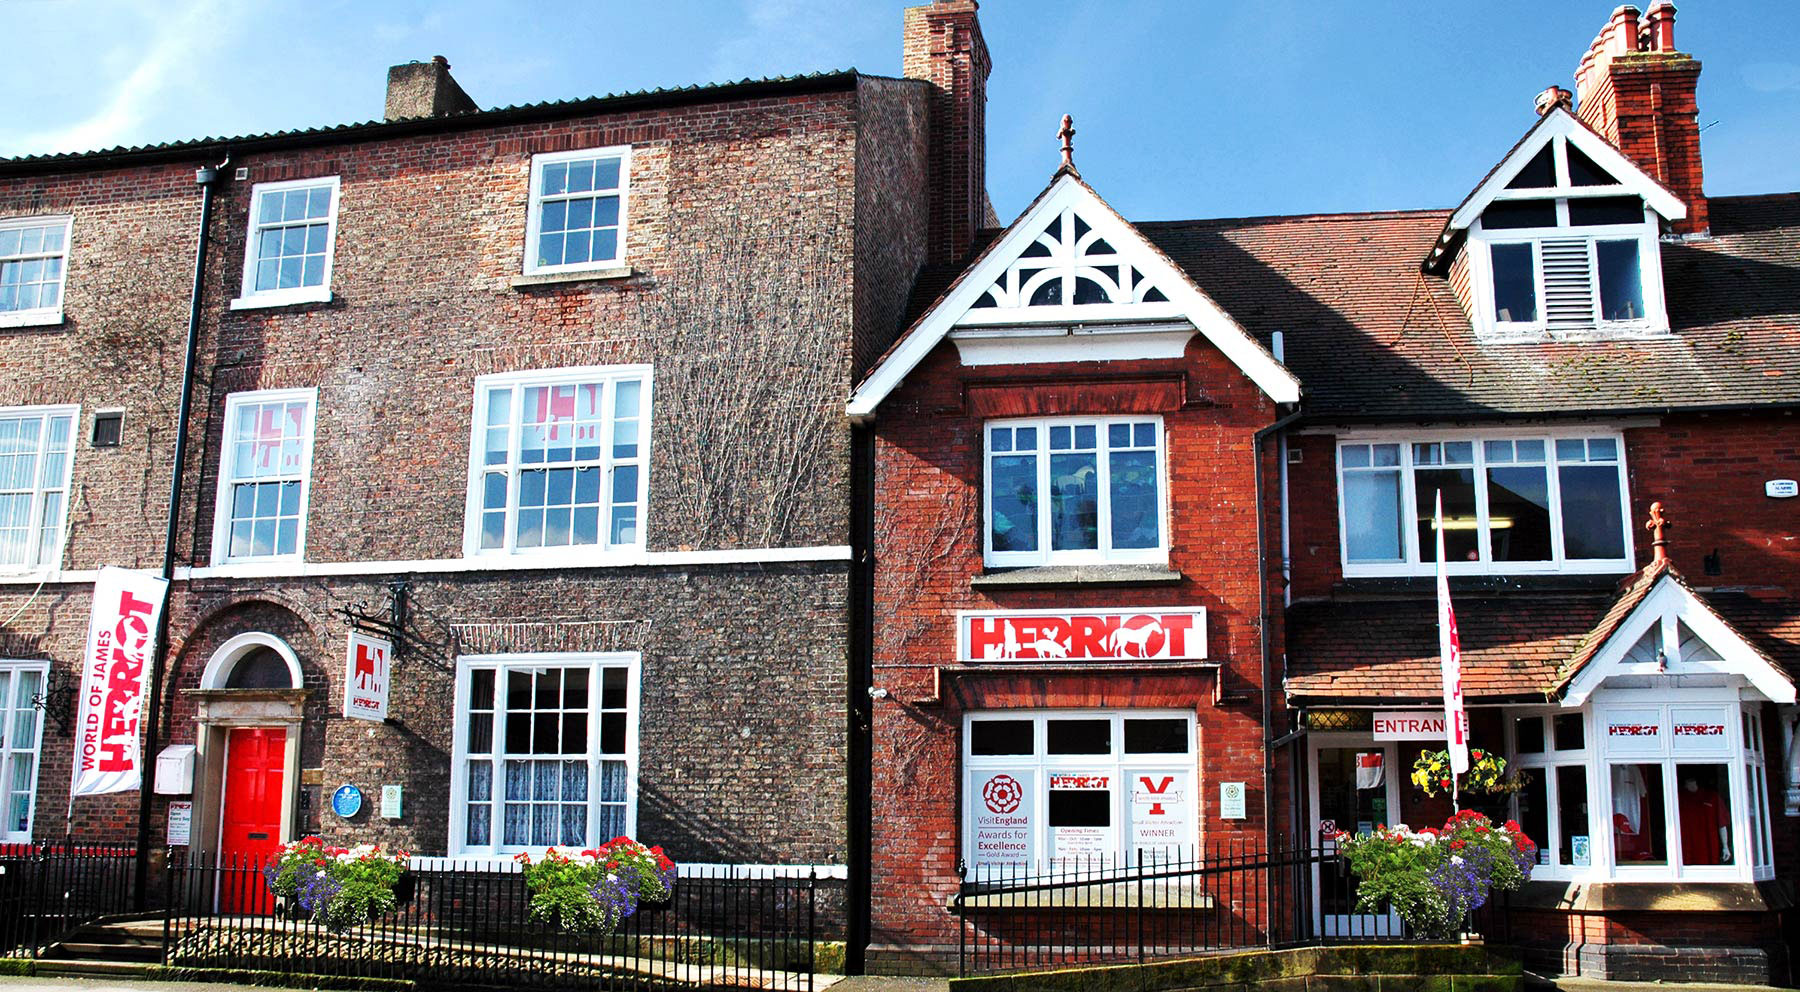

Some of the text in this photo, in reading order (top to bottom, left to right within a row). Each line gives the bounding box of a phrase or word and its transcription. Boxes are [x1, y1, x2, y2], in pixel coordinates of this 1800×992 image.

[970, 614, 1193, 660] HERRIOT
[99, 590, 154, 773] HERRIOT
[81, 630, 111, 772] WORLD OF JAMES
[1374, 719, 1469, 733] ENTRANE
[1608, 725, 1659, 736] HERRIOT
[1674, 725, 1725, 736] HERRIOT
[1050, 776, 1110, 789] HERRIOT
[978, 816, 1028, 826] VisitEngland
[978, 830, 1028, 839] Awards for
[1140, 829, 1175, 837] WINNER
[978, 841, 1027, 850] Excellence
